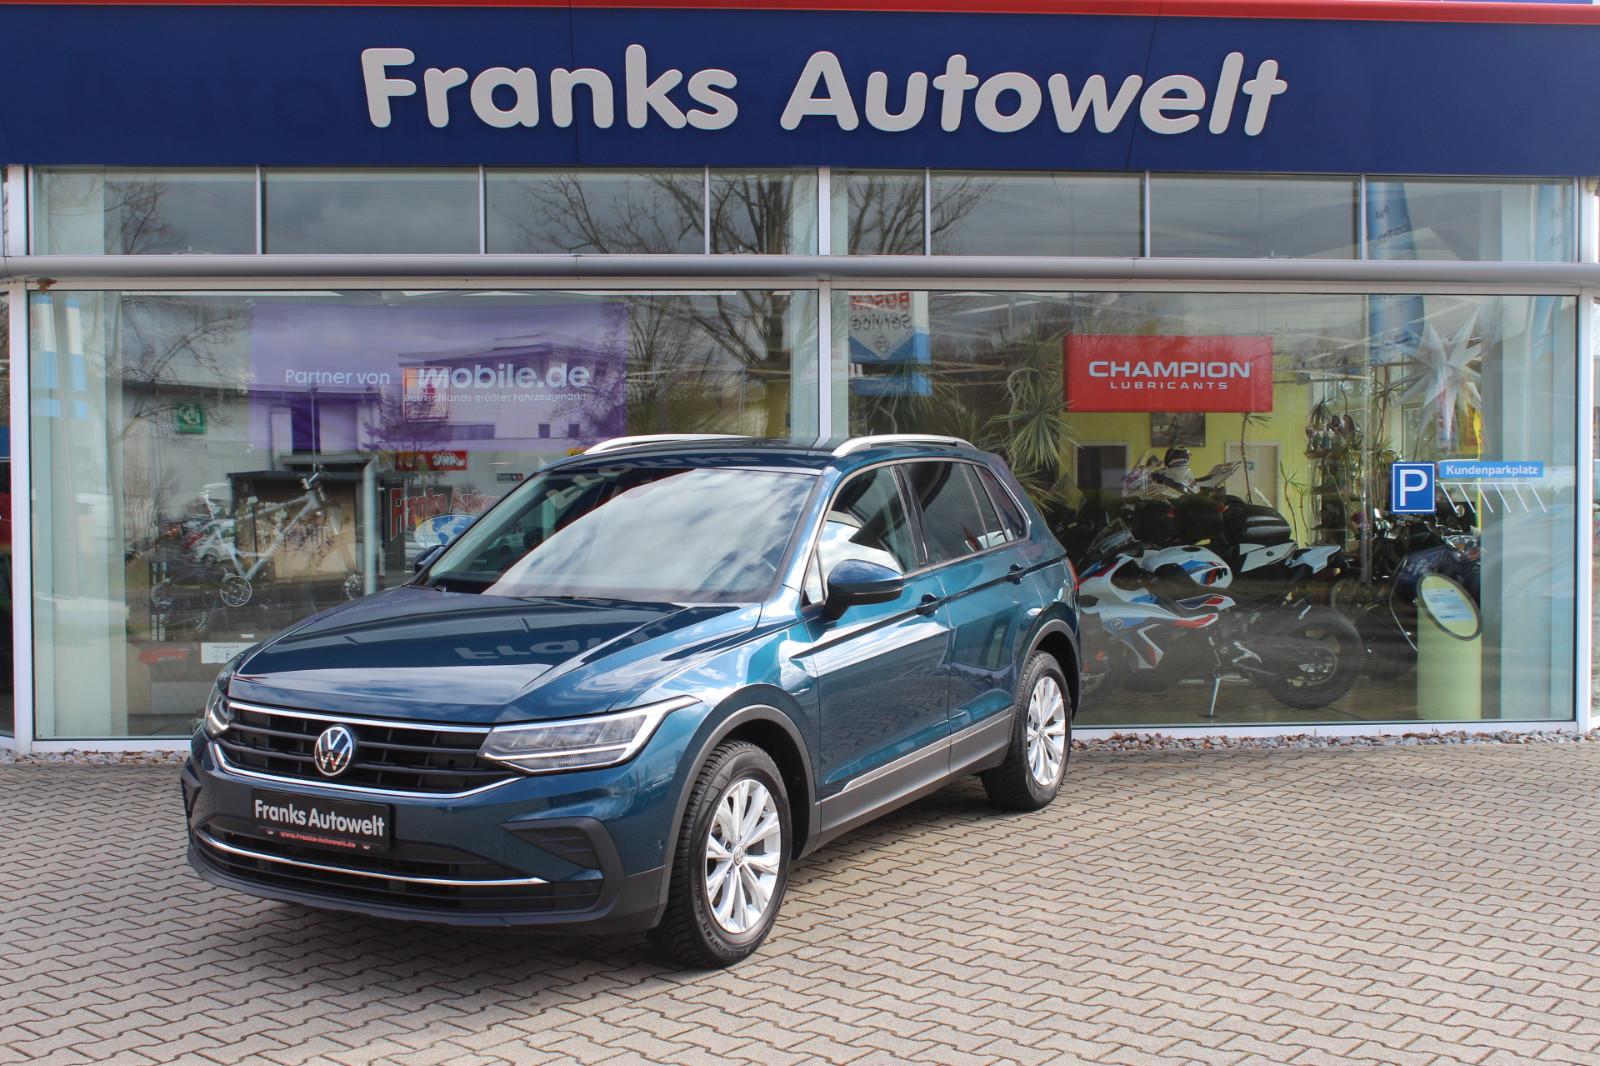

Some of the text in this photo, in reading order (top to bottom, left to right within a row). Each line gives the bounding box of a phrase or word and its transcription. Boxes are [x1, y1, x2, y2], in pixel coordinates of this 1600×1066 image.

[361, 44, 1288, 136] Franks Autowelt
[285, 369, 391, 385] Partner von
[418, 363, 590, 389] mobile.de
[1088, 361, 1250, 378] CHAMPION
[1110, 381, 1228, 390] LUBRICANTS
[1446, 465, 1538, 476] Kundenparkplatz
[1399, 469, 1428, 507] P
[254, 799, 385, 837] Franks Autowelt
